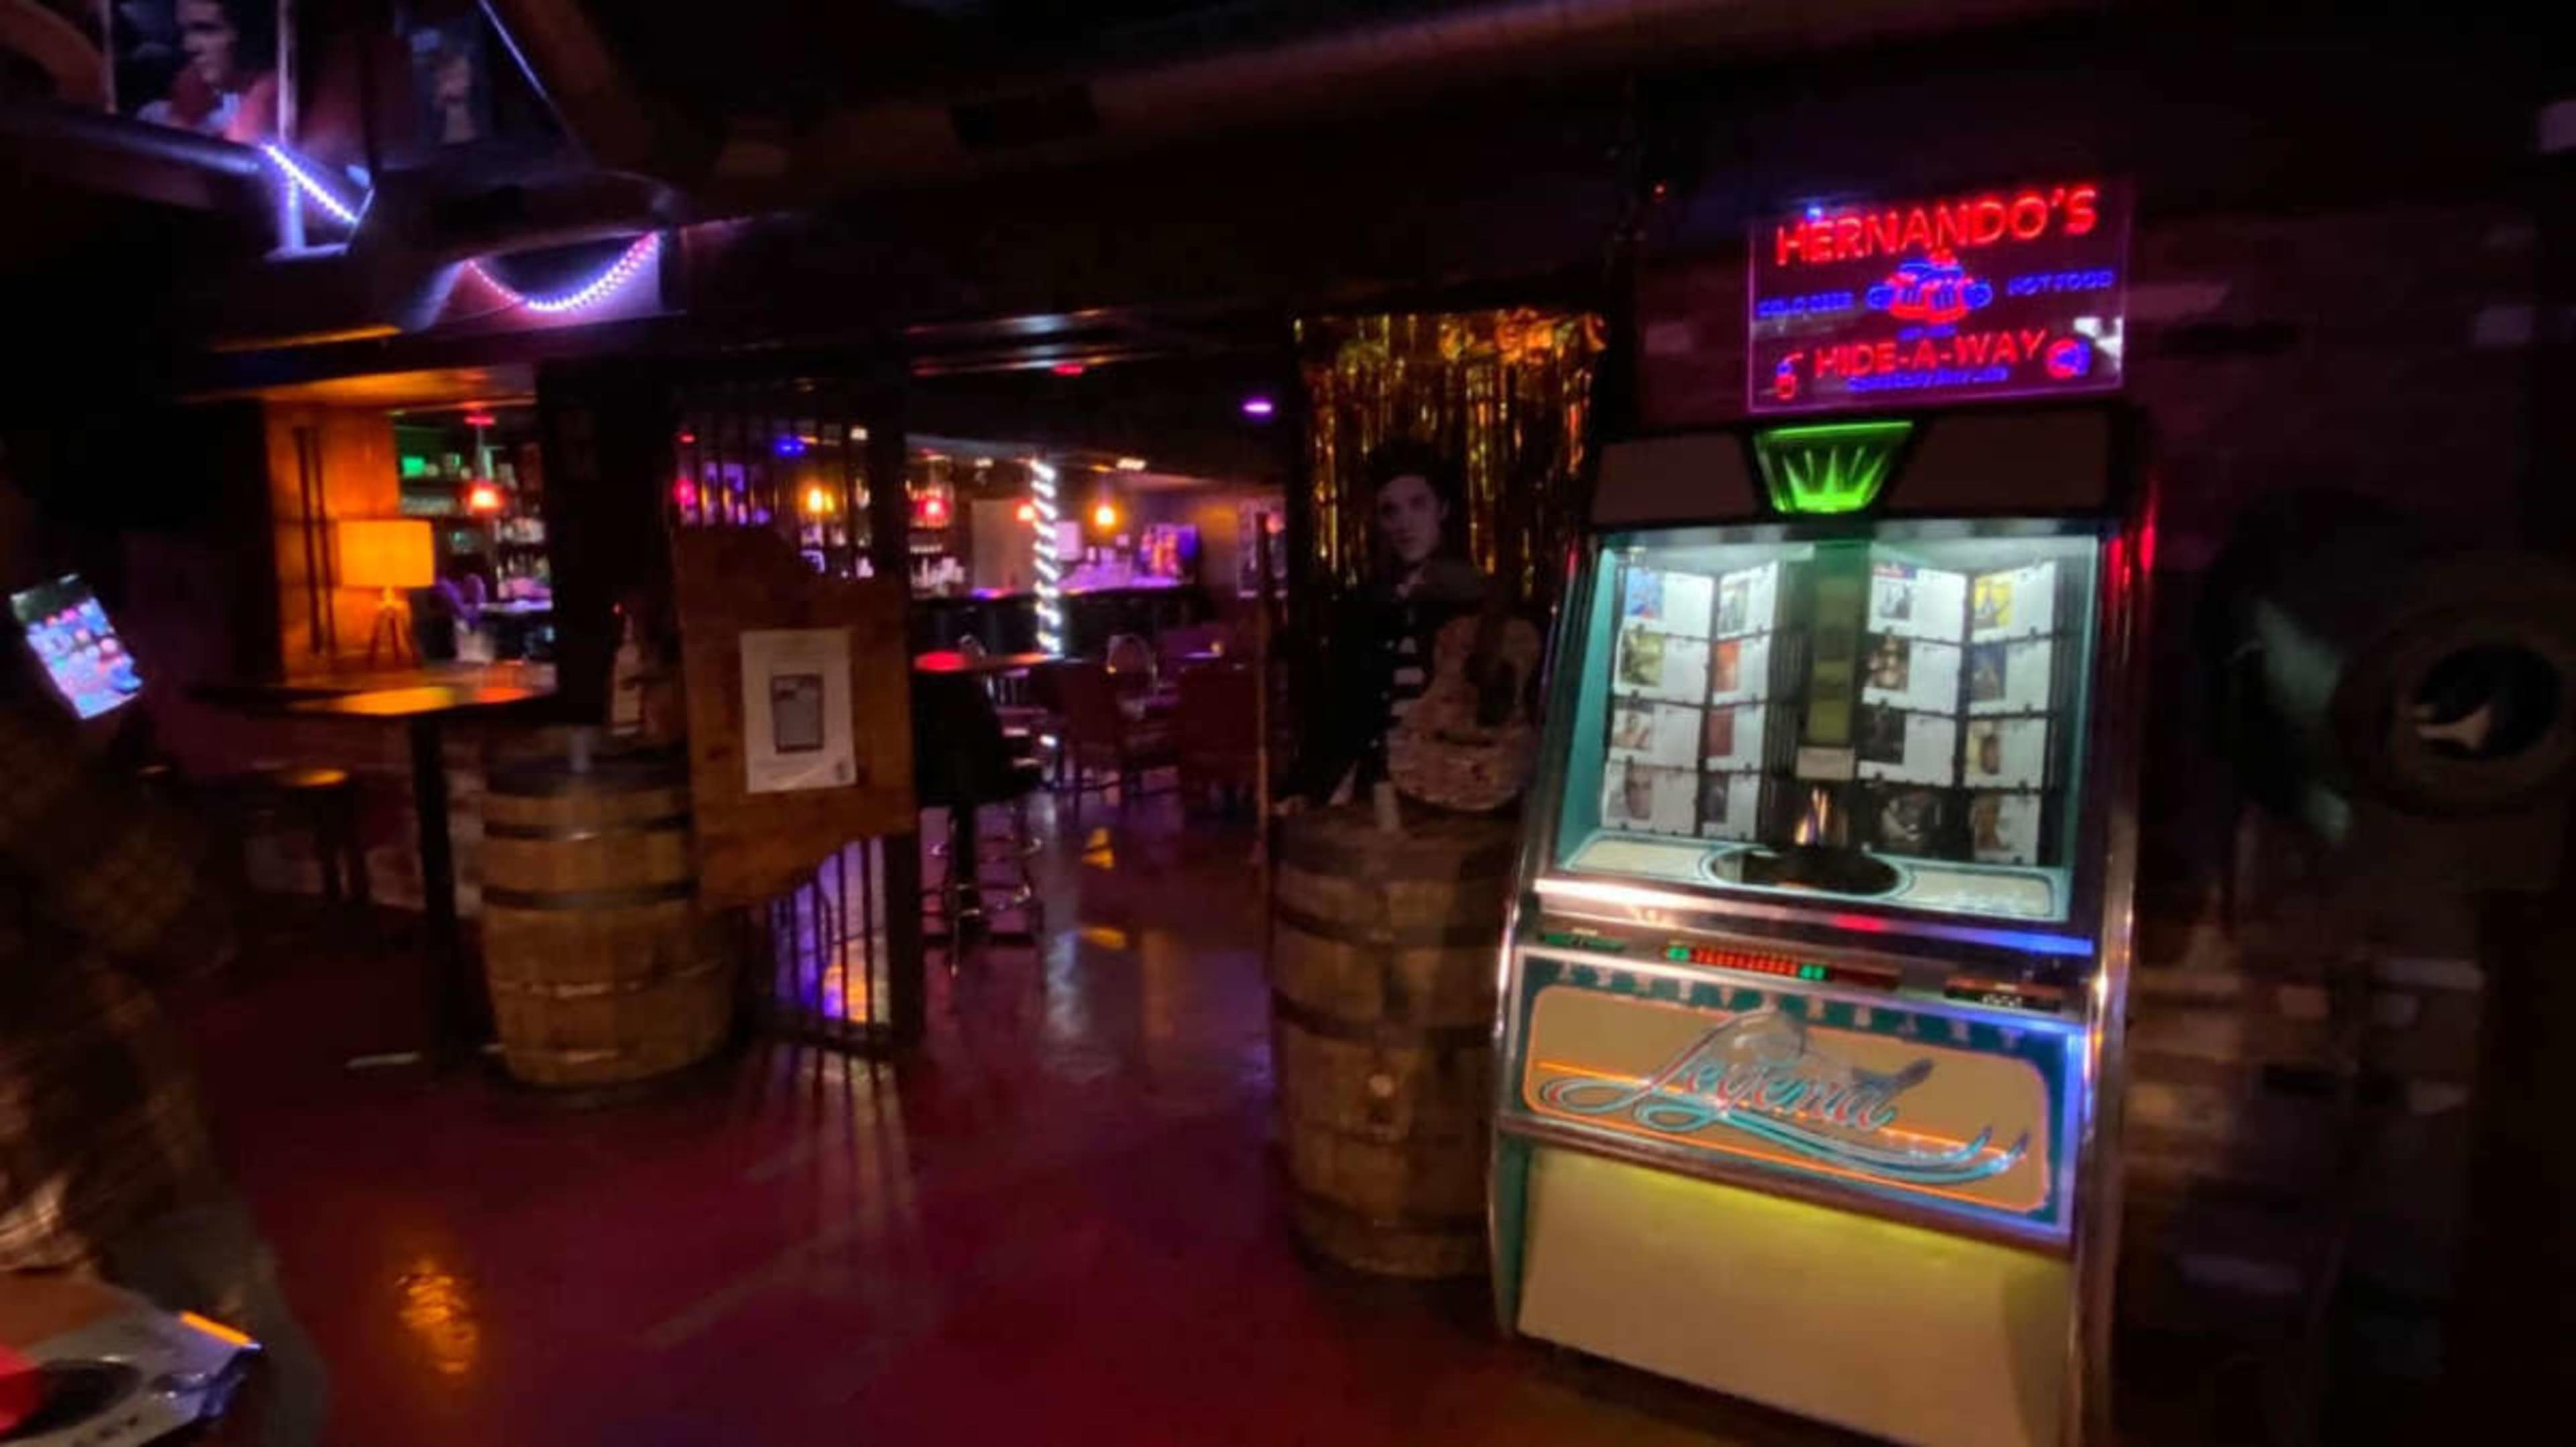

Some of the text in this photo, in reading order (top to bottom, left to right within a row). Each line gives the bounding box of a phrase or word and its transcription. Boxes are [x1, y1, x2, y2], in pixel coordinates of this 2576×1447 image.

[1776, 187, 2096, 266] HERNANDO'S
[1815, 329, 2046, 378] HIDE-A-WAY
[1541, 1006, 1907, 1140] Legend
